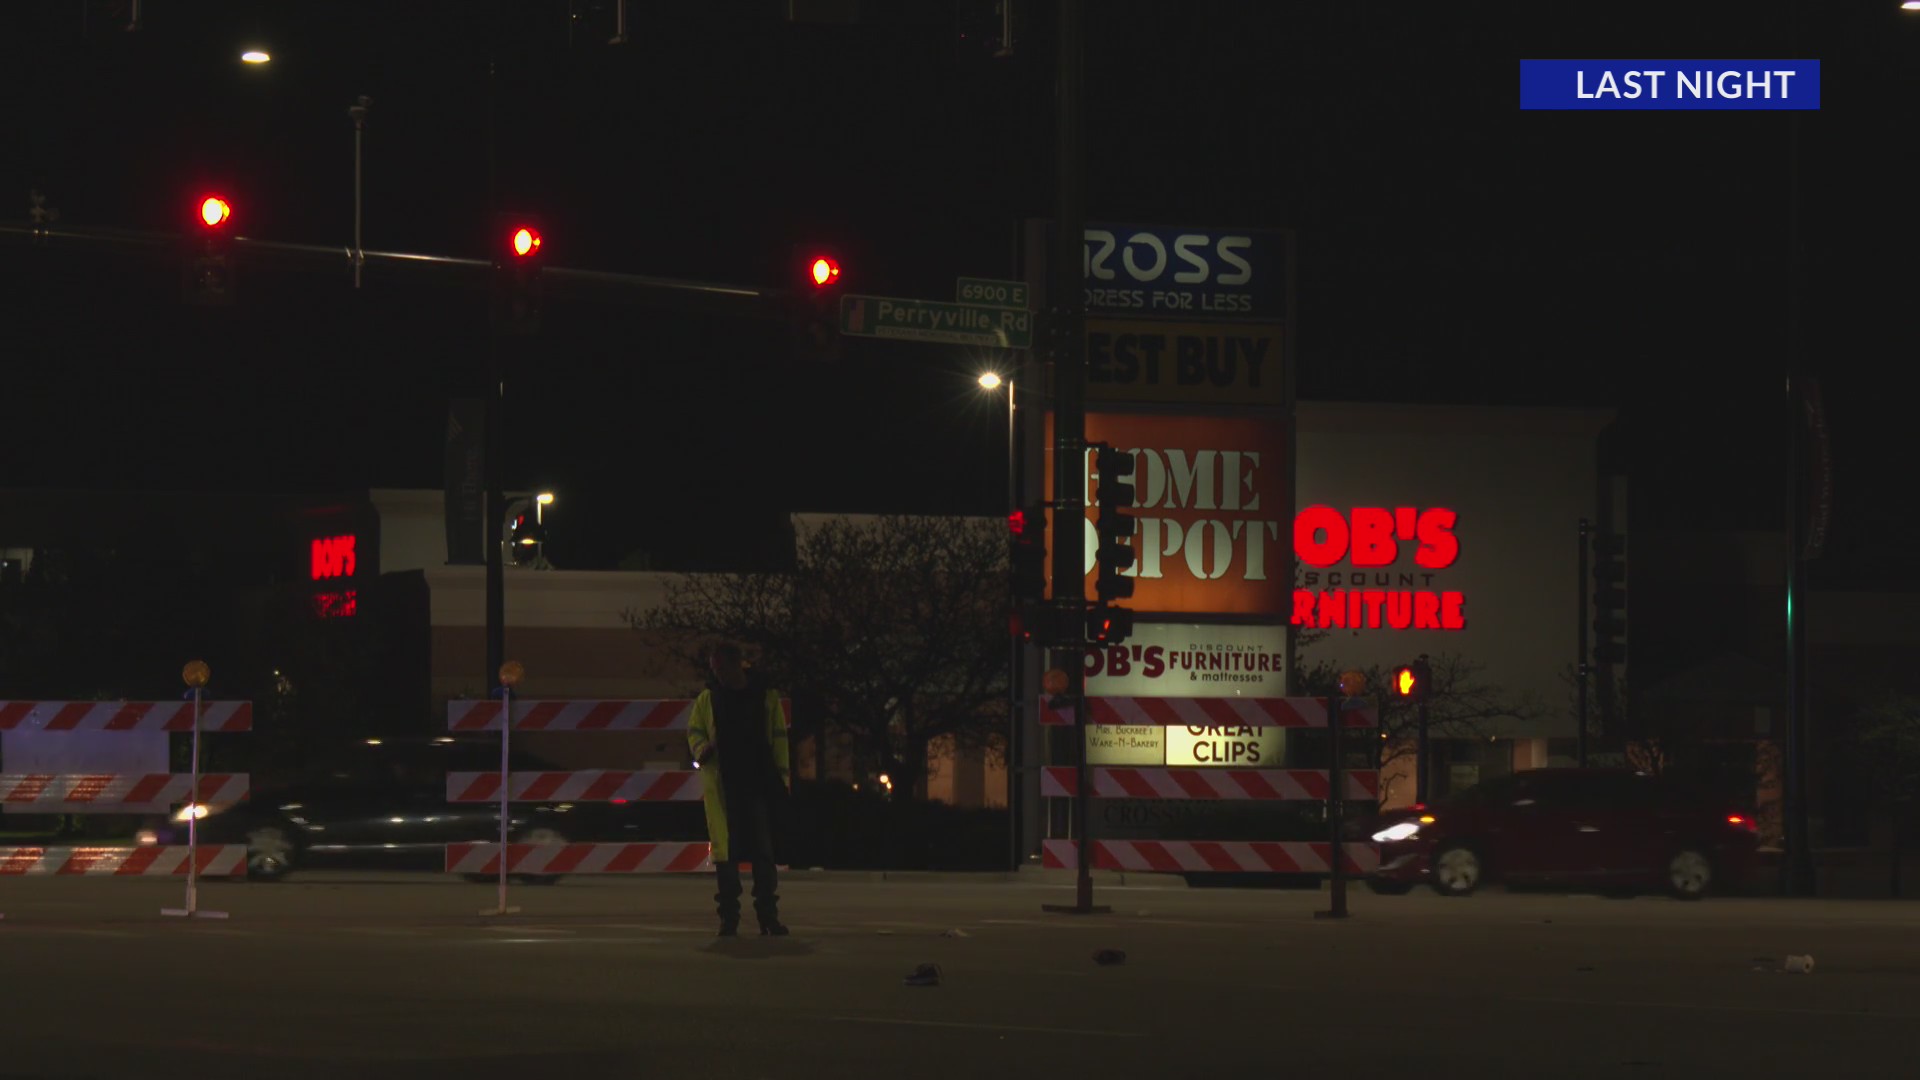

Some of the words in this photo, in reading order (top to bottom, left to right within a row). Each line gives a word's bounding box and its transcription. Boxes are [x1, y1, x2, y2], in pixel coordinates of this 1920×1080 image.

[1084, 230, 1252, 285] ROSS
[962, 285, 1007, 301] 6900
[1013, 288, 1023, 302] E
[1152, 291, 1193, 309] FOR
[1201, 293, 1252, 312] LESS
[878, 301, 991, 329] Perryville
[1000, 311, 1028, 332] Rd
[1088, 333, 1166, 385] EST
[1176, 335, 1273, 388] BUY
[1293, 506, 1460, 569] OB'S
[1304, 572, 1436, 586] SCOUNT
[1290, 589, 1465, 629] RNITURE
[1189, 644, 1264, 652] DISCOUNT
[1084, 645, 1165, 678] OB'S
[1169, 651, 1283, 672] FURNITURE
[1190, 671, 1197, 681] &
[1201, 672, 1264, 682] mattresses
[1193, 741, 1261, 763] CLIPS
